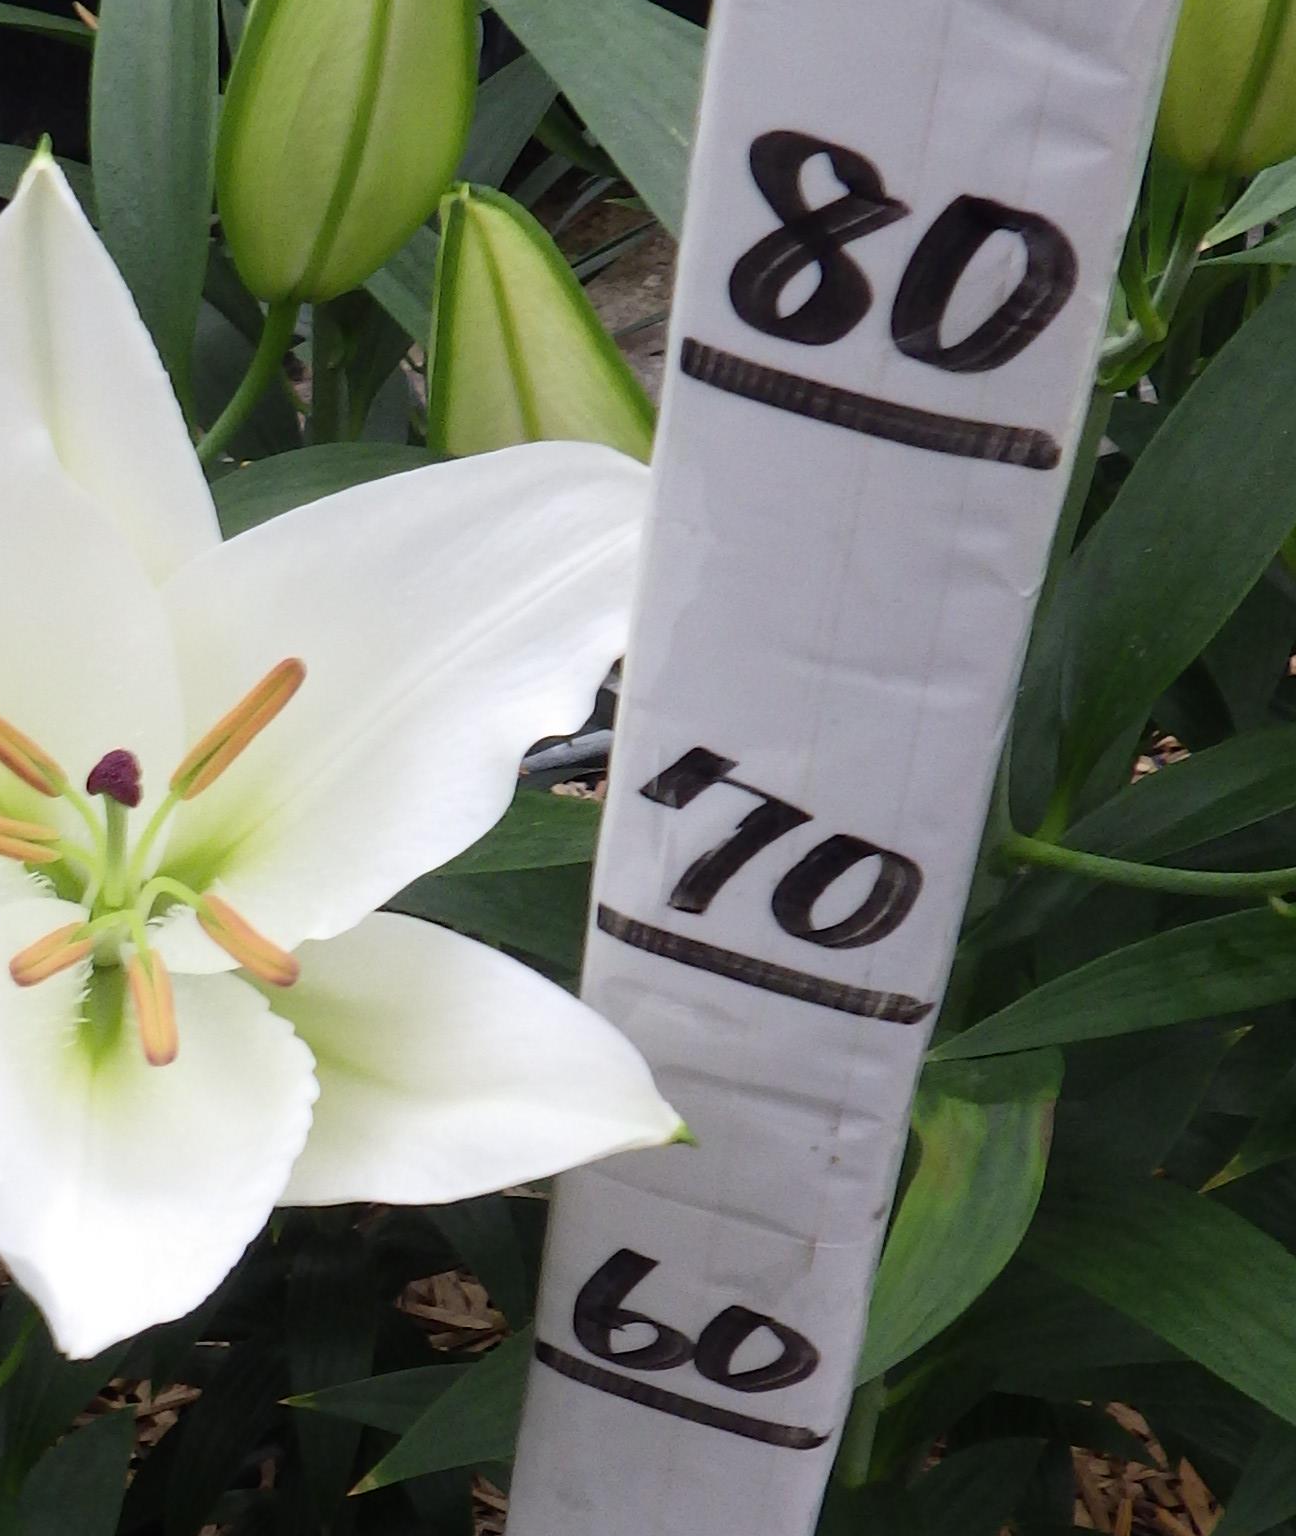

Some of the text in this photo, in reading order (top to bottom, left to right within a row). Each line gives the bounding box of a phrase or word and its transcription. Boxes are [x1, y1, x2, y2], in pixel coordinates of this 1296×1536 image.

[728, 130, 1079, 373] 80
[639, 746, 924, 950] 70
[573, 1247, 821, 1393] 60
